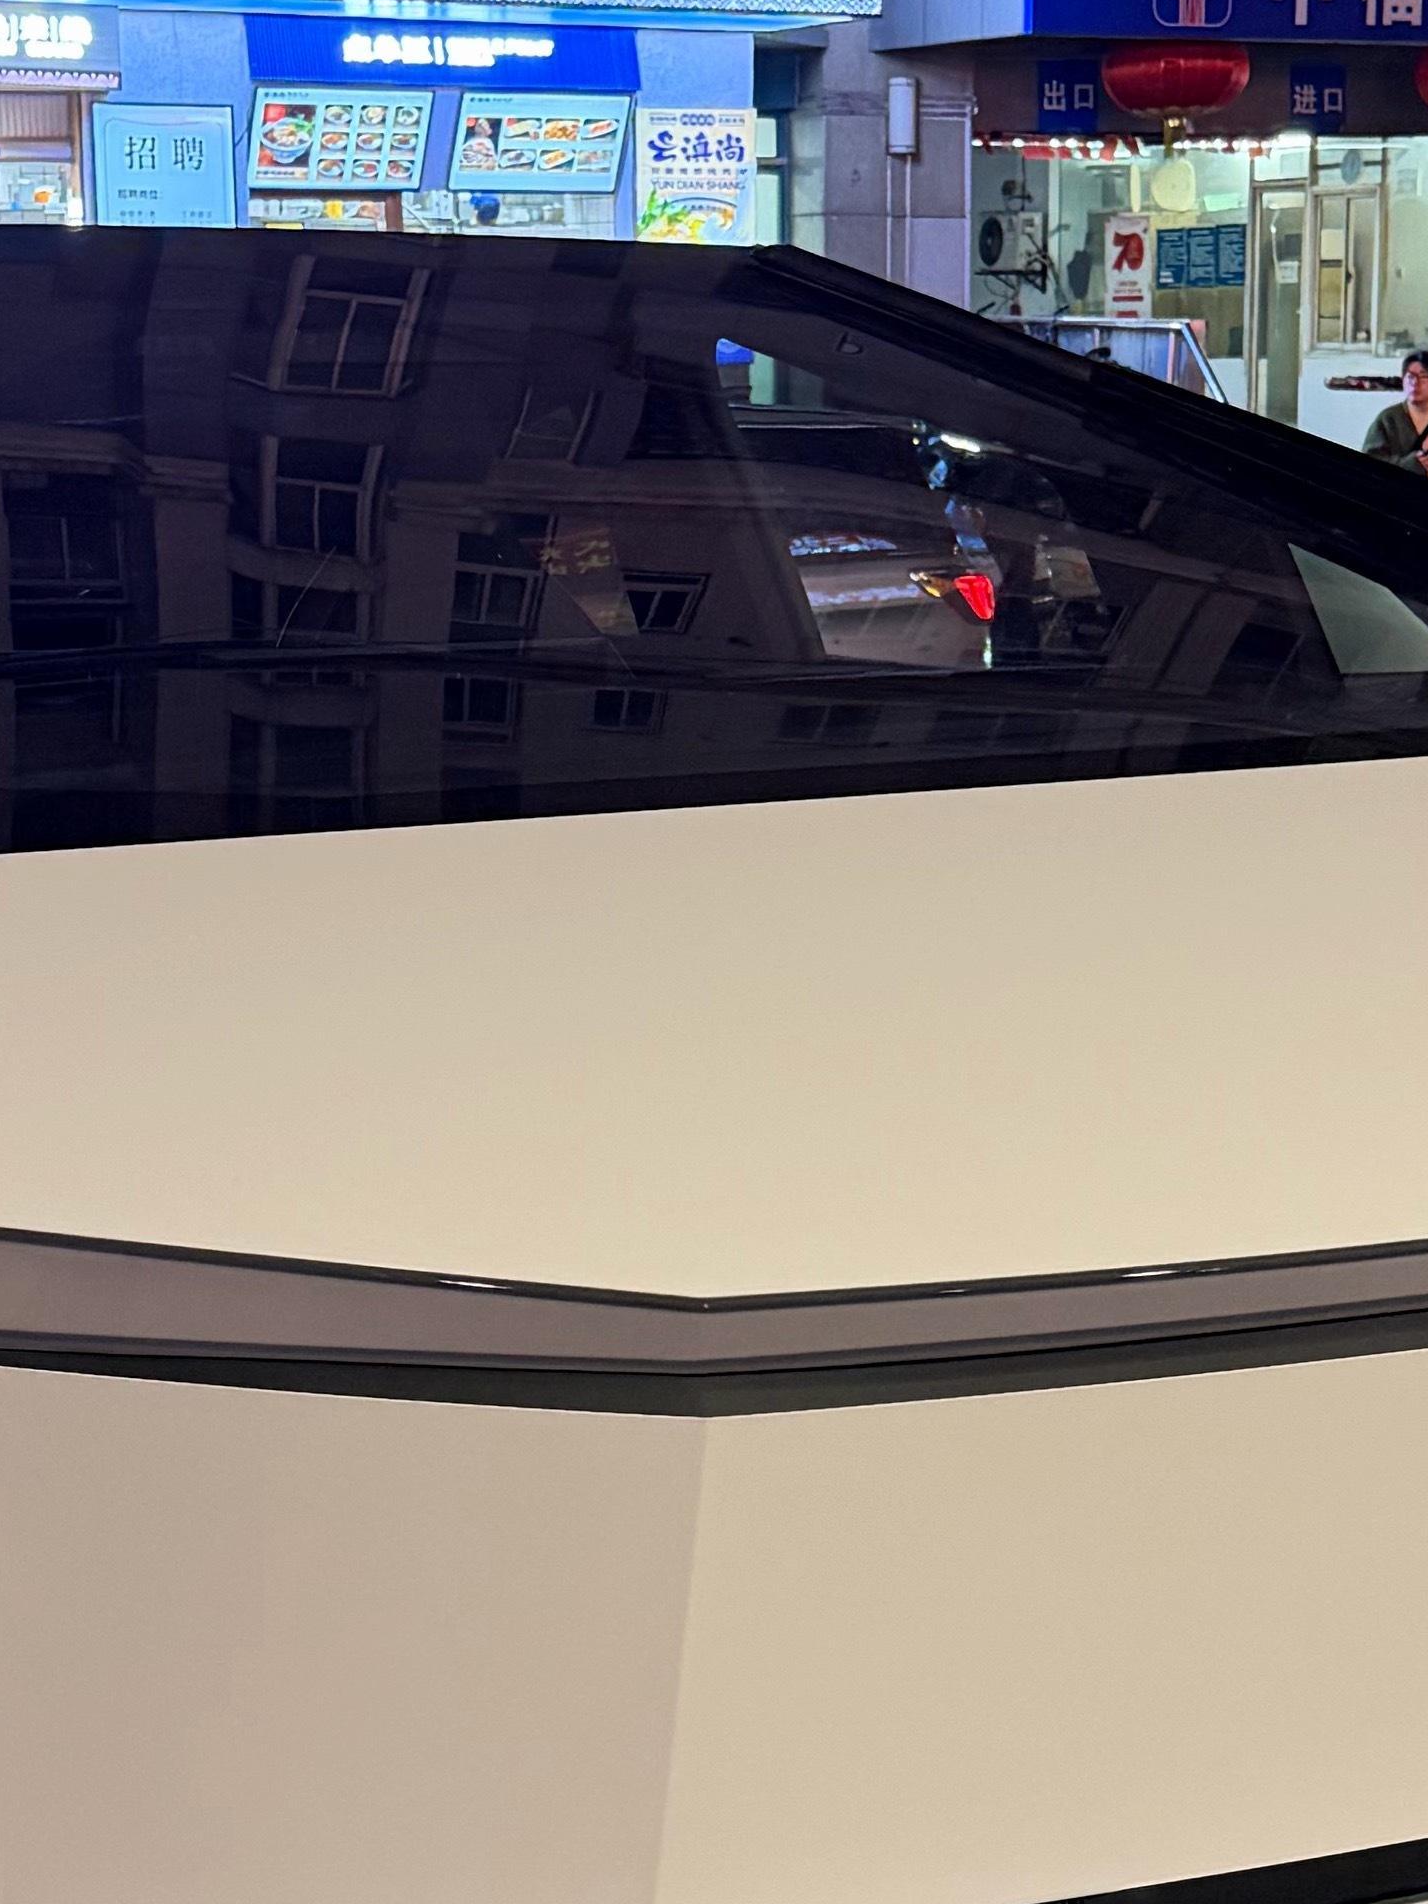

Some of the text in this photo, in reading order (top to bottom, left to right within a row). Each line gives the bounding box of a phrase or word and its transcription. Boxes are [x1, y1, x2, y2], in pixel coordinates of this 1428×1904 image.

[1043, 80, 1094, 112] 出口
[1293, 84, 1343, 114] 进口
[125, 136, 204, 170] 招聘
